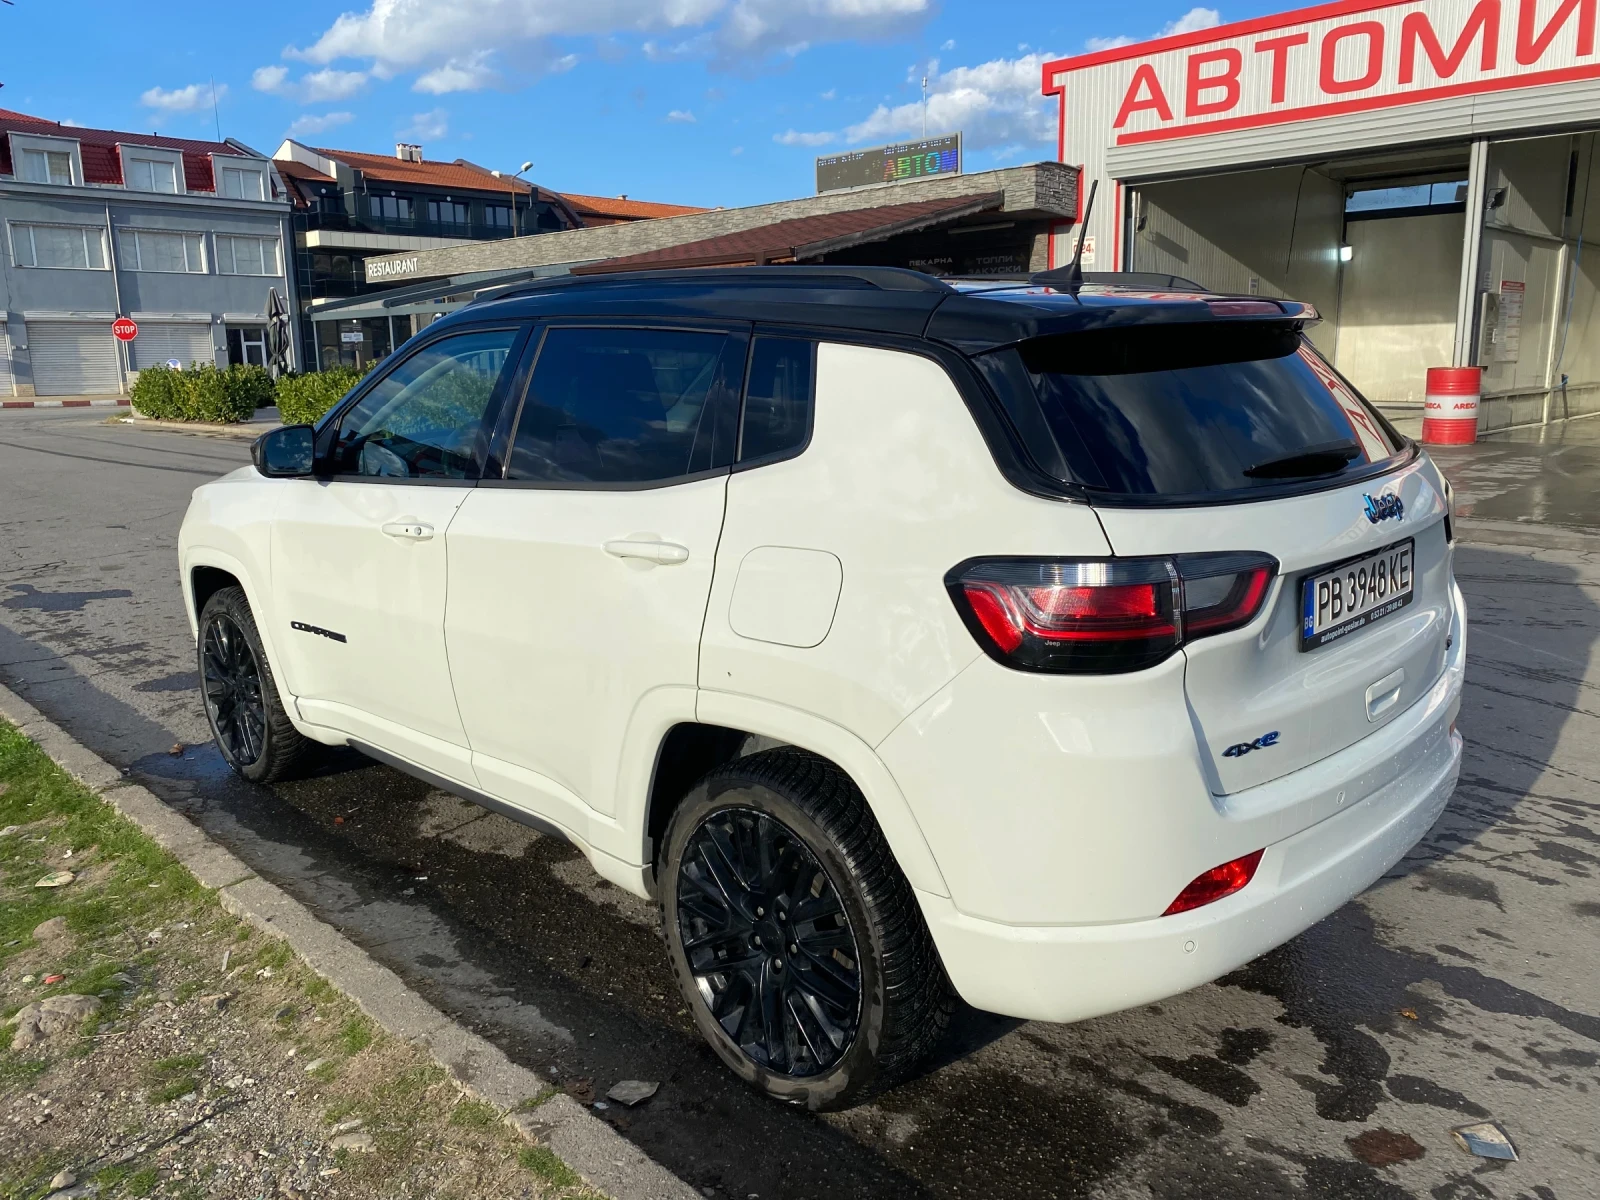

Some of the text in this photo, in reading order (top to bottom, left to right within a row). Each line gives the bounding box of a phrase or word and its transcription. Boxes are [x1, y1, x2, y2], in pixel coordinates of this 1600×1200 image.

[1113, 0, 1597, 129] АВТОМИ
[368, 258, 418, 277] RESTAURANT
[909, 257, 953, 267] ПЕКАРНА
[976, 255, 1013, 265] ТОПЛИ
[115, 325, 135, 334] STOP
[1362, 492, 1403, 524] Jeep
[1316, 547, 1409, 627] PB 3948 KE
[1304, 615, 1314, 630] BG
